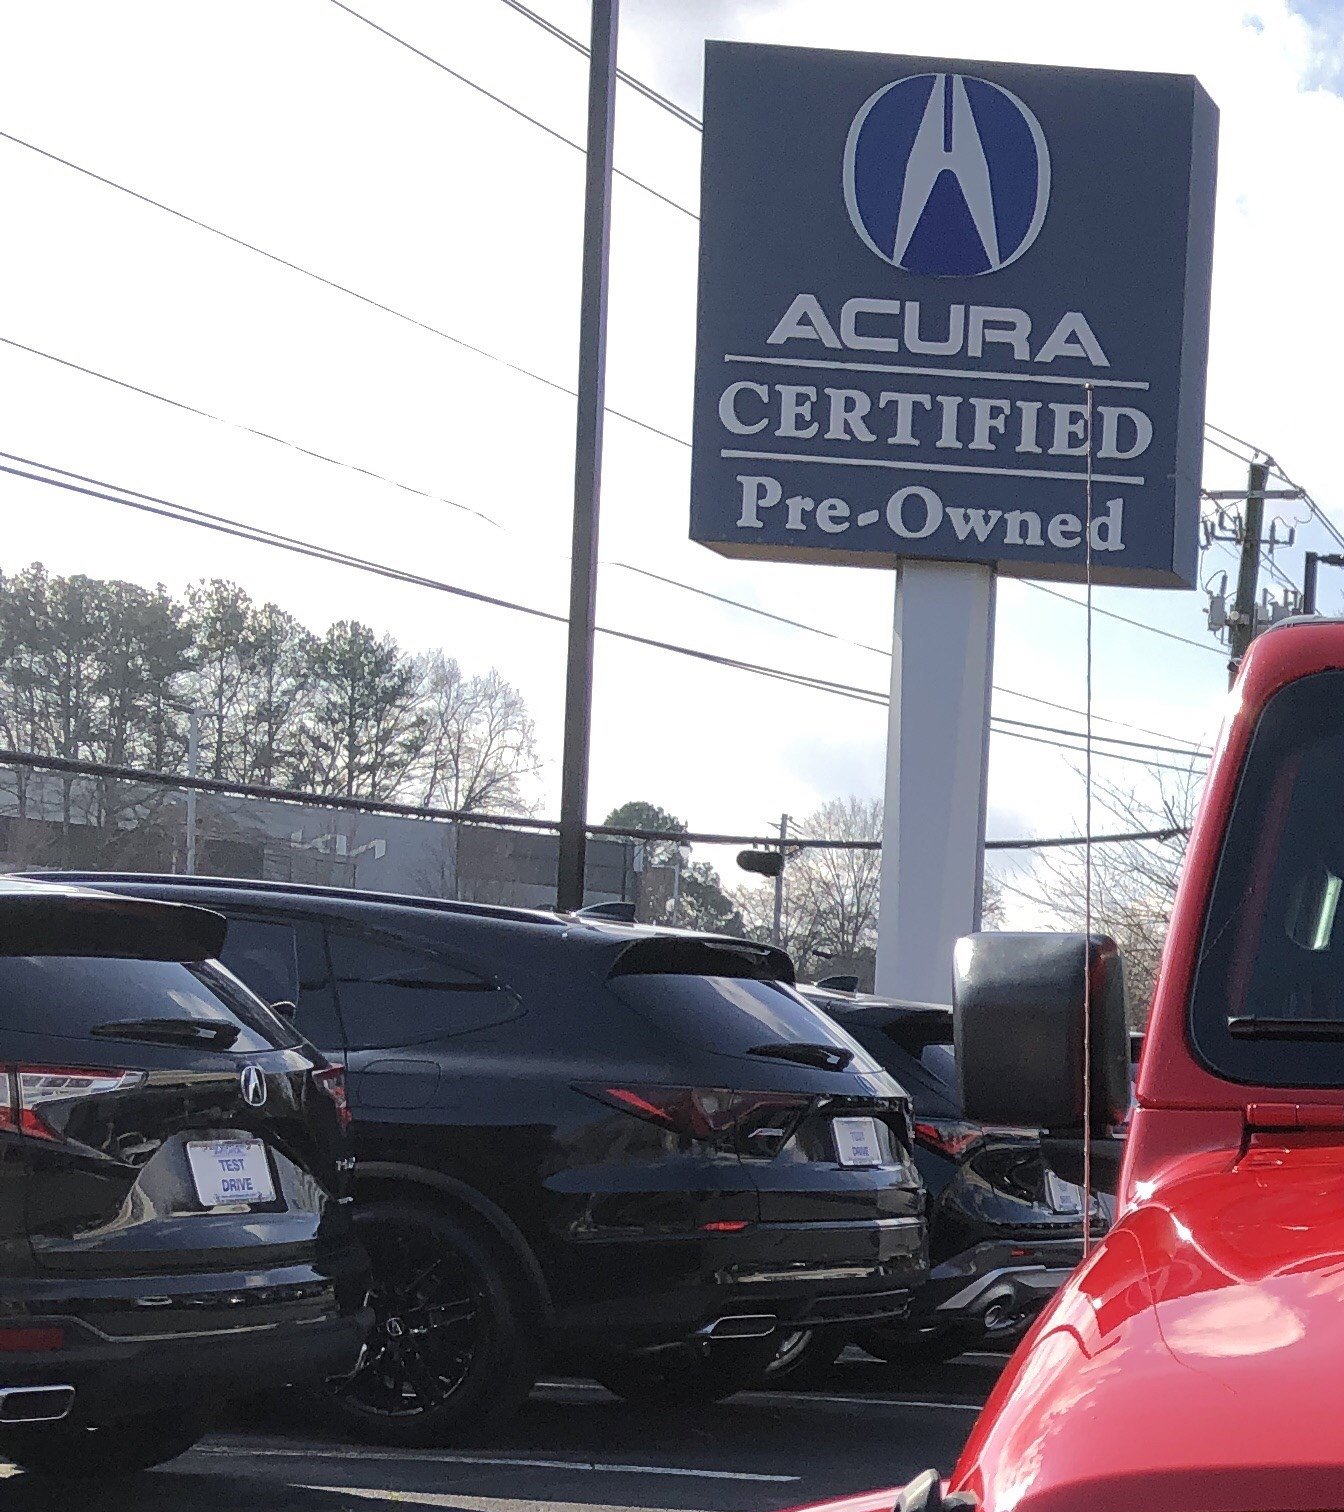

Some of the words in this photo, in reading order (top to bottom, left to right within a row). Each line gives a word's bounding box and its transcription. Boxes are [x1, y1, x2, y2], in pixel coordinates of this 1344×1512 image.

[766, 293, 1111, 367] ACURA
[718, 380, 1153, 460] CERTIFIED
[736, 475, 1126, 552] Pre-Owned
[218, 1159, 245, 1173] TEST
[222, 1178, 254, 1193] DRIVE
